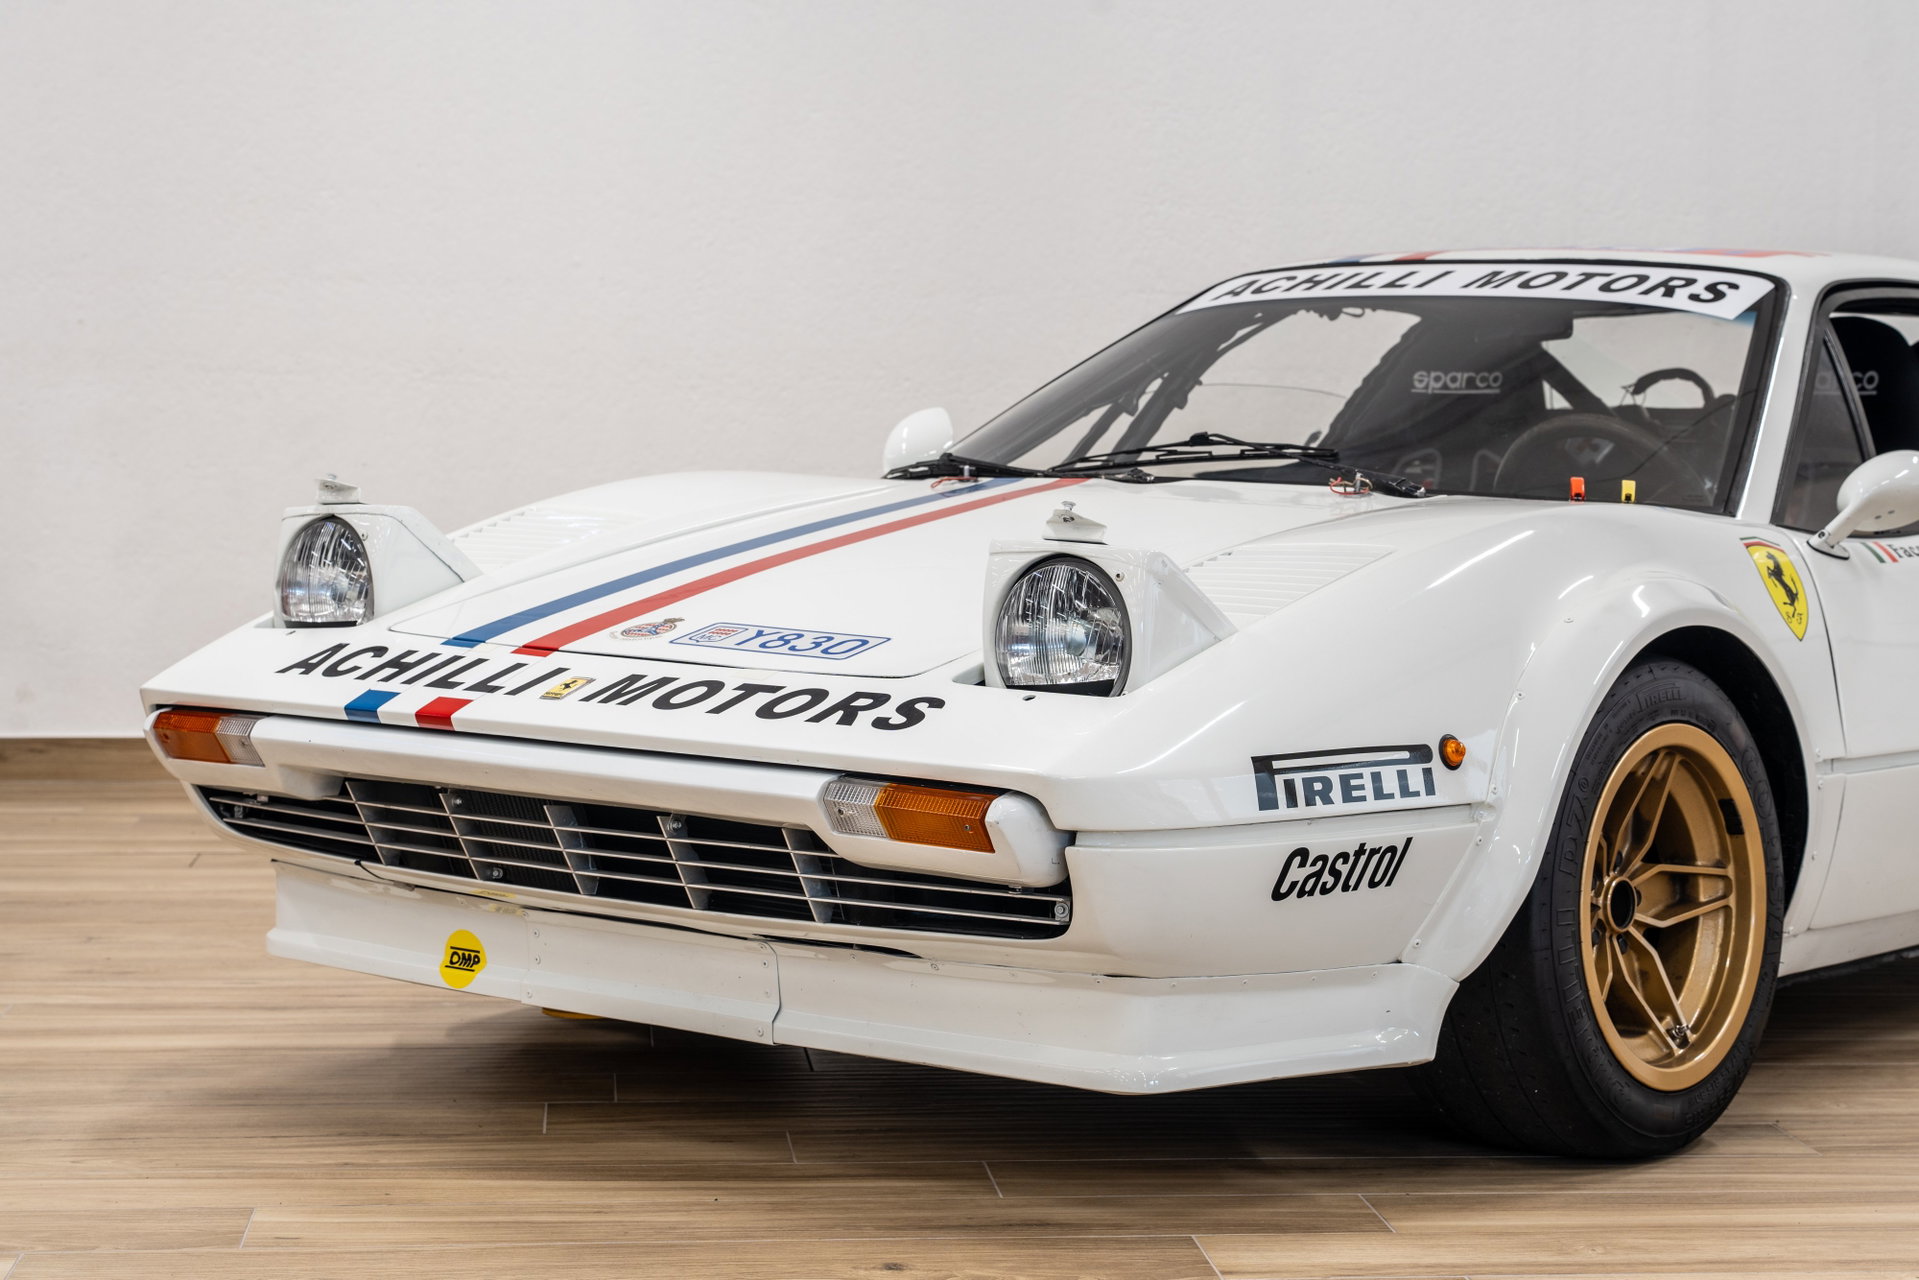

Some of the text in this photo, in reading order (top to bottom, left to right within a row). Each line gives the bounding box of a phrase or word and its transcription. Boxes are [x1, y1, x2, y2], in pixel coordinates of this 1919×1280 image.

[1211, 270, 1740, 303] ACHILLI MOTORS
[1411, 370, 1503, 394] sparco
[734, 629, 870, 655] Y830
[275, 642, 946, 732] ACHILLI MOTORS
[1251, 743, 1436, 812] PIRELLI
[1270, 836, 1414, 902] Castrol
[449, 951, 481, 968] OMP
